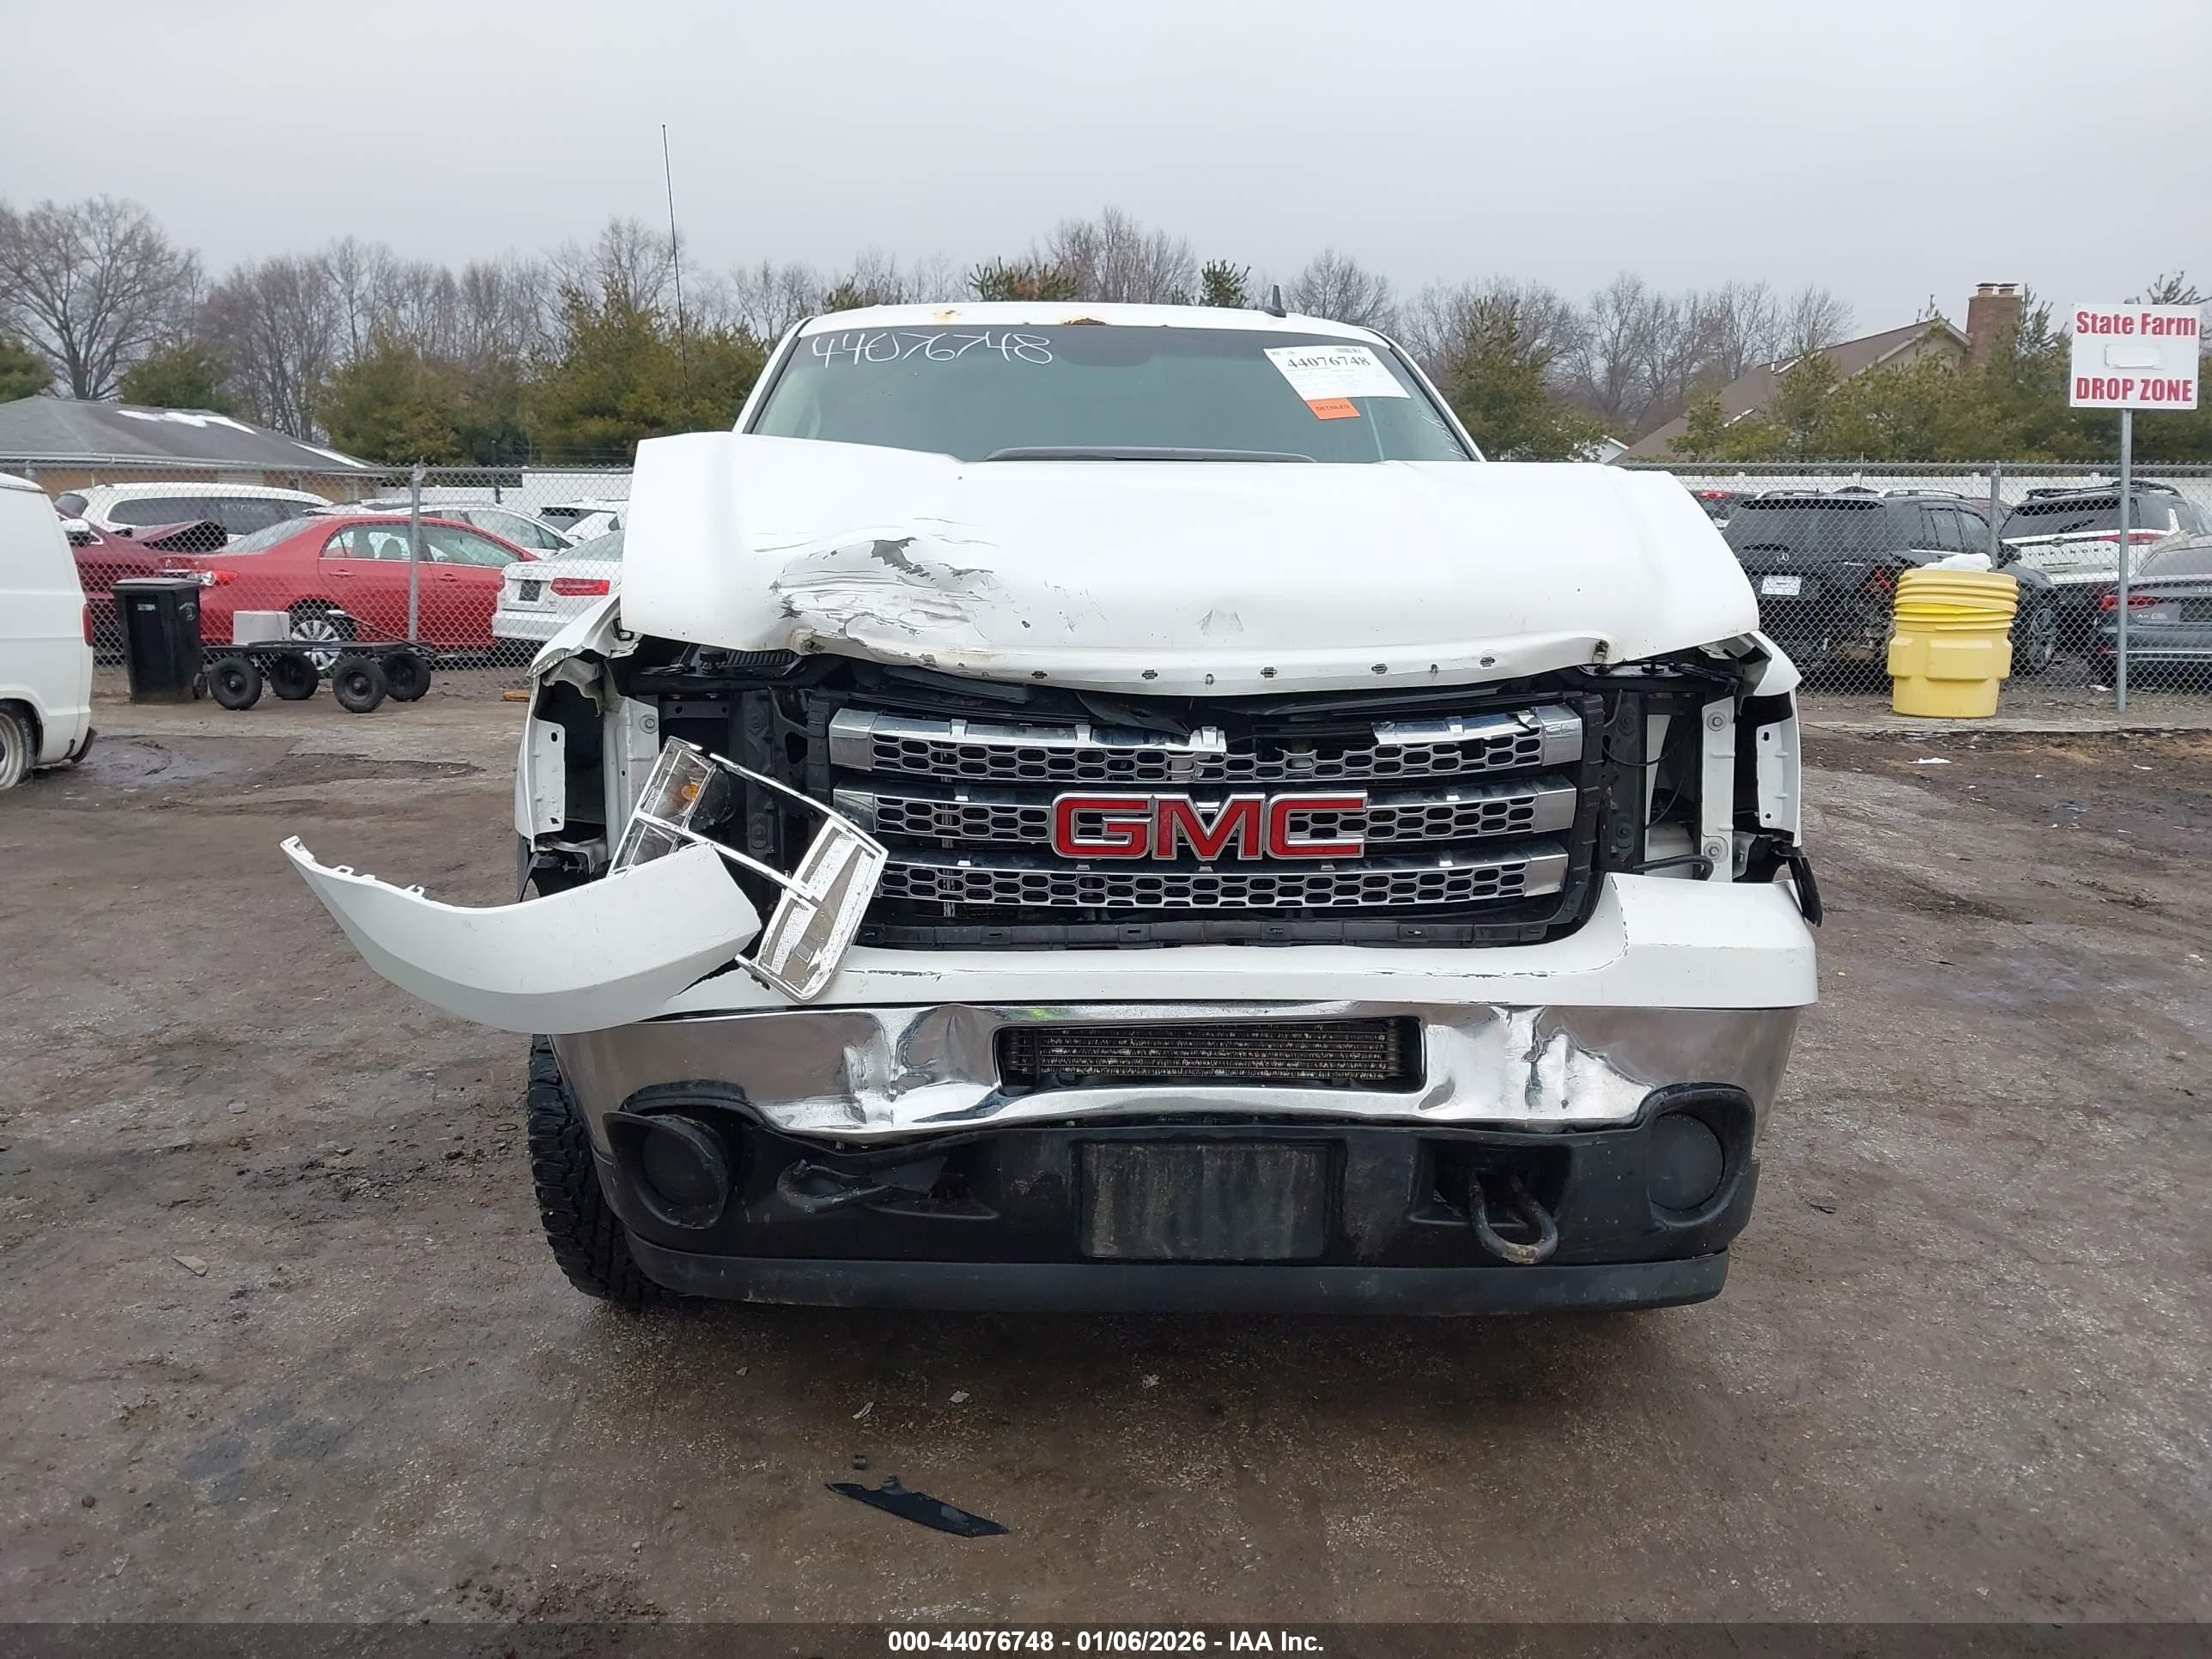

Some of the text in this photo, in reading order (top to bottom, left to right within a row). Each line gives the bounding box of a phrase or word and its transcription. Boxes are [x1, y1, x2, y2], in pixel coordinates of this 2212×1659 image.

[2076, 311, 2197, 336] State Farm
[811, 331, 1053, 368] 44076748
[1287, 356, 1371, 368] 44076748
[2075, 377, 2193, 401] DROP ZONE
[1315, 404, 1352, 412] DETAILED
[1050, 790, 1369, 861] GMC
